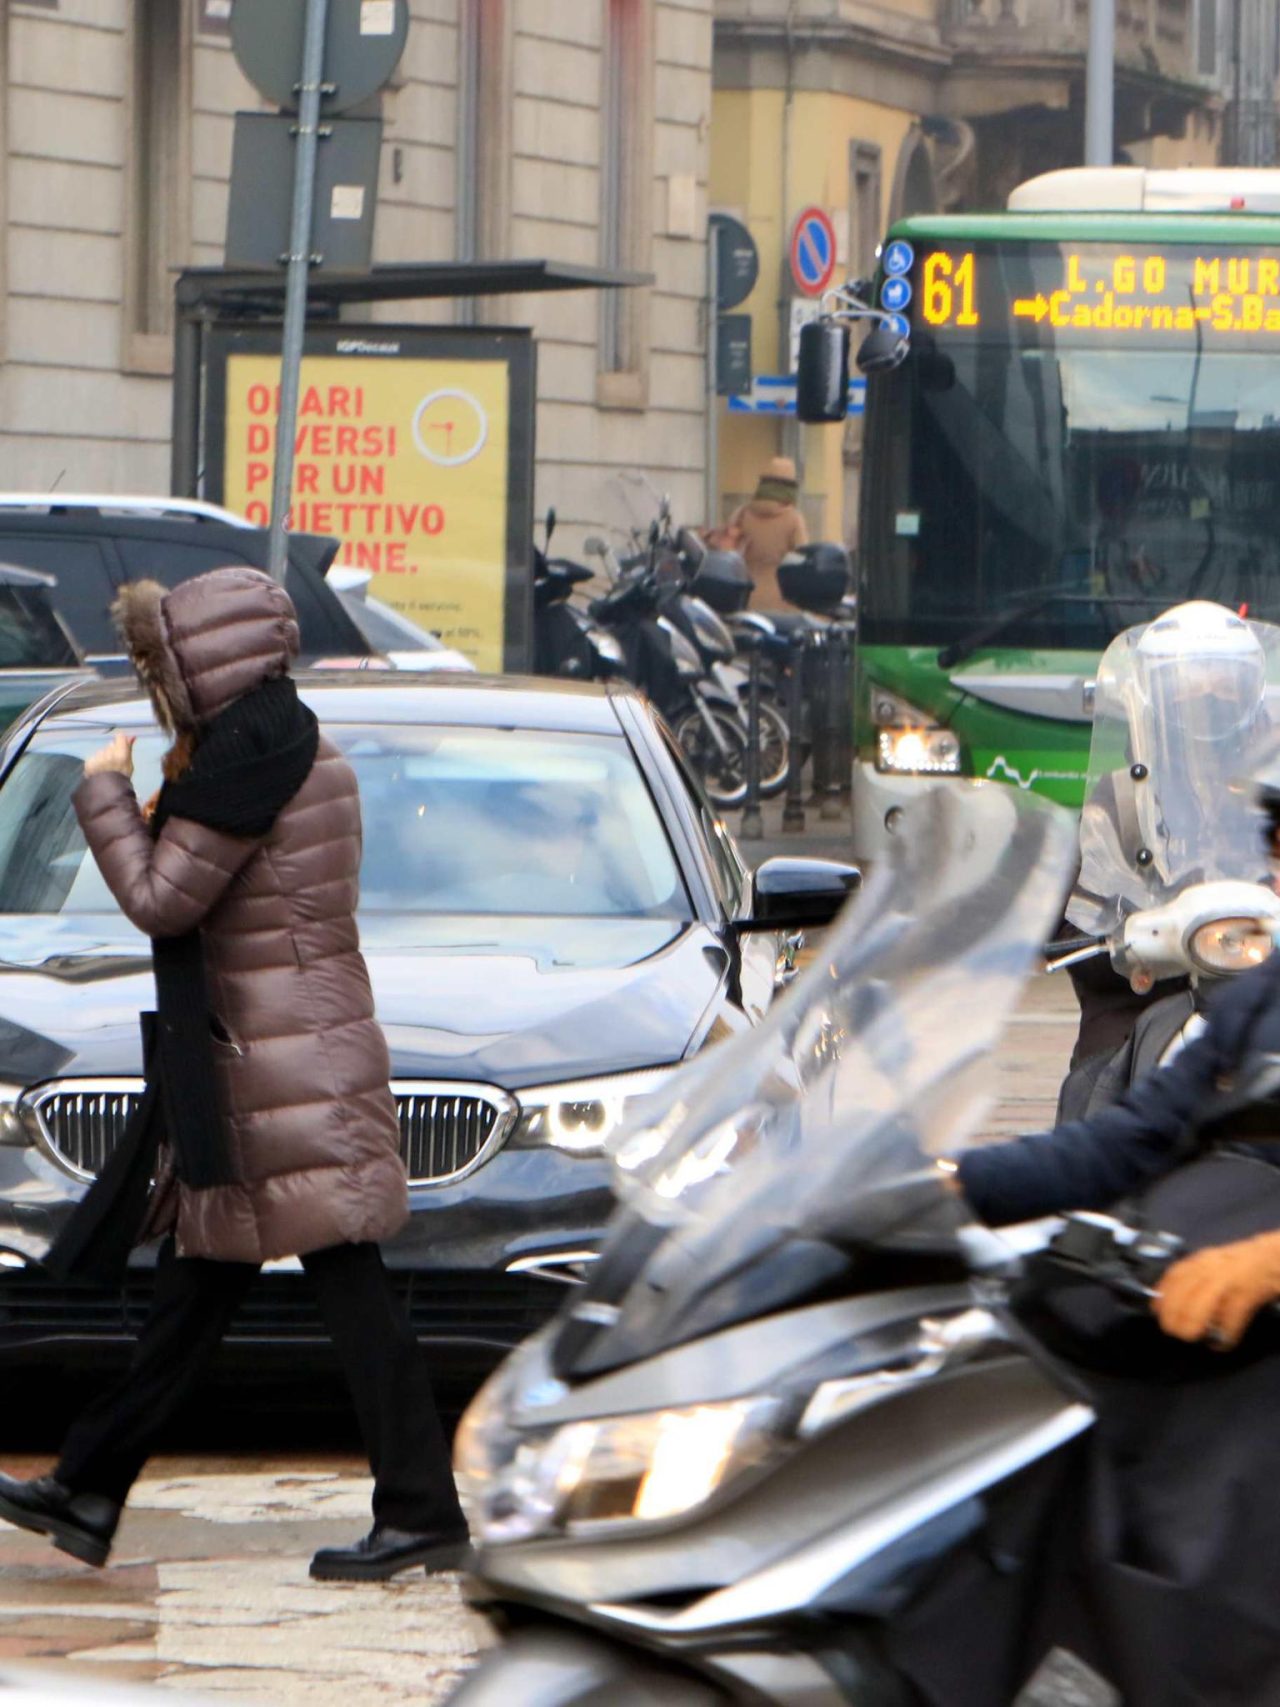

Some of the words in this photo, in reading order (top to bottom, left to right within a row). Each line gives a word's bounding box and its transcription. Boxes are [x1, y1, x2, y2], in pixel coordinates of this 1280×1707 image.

[923, 252, 979, 326] 61
[1067, 254, 1167, 294] L.GO
[247, 423, 397, 458] DVERSI
[246, 462, 321, 494] PR
[332, 465, 386, 497] UN
